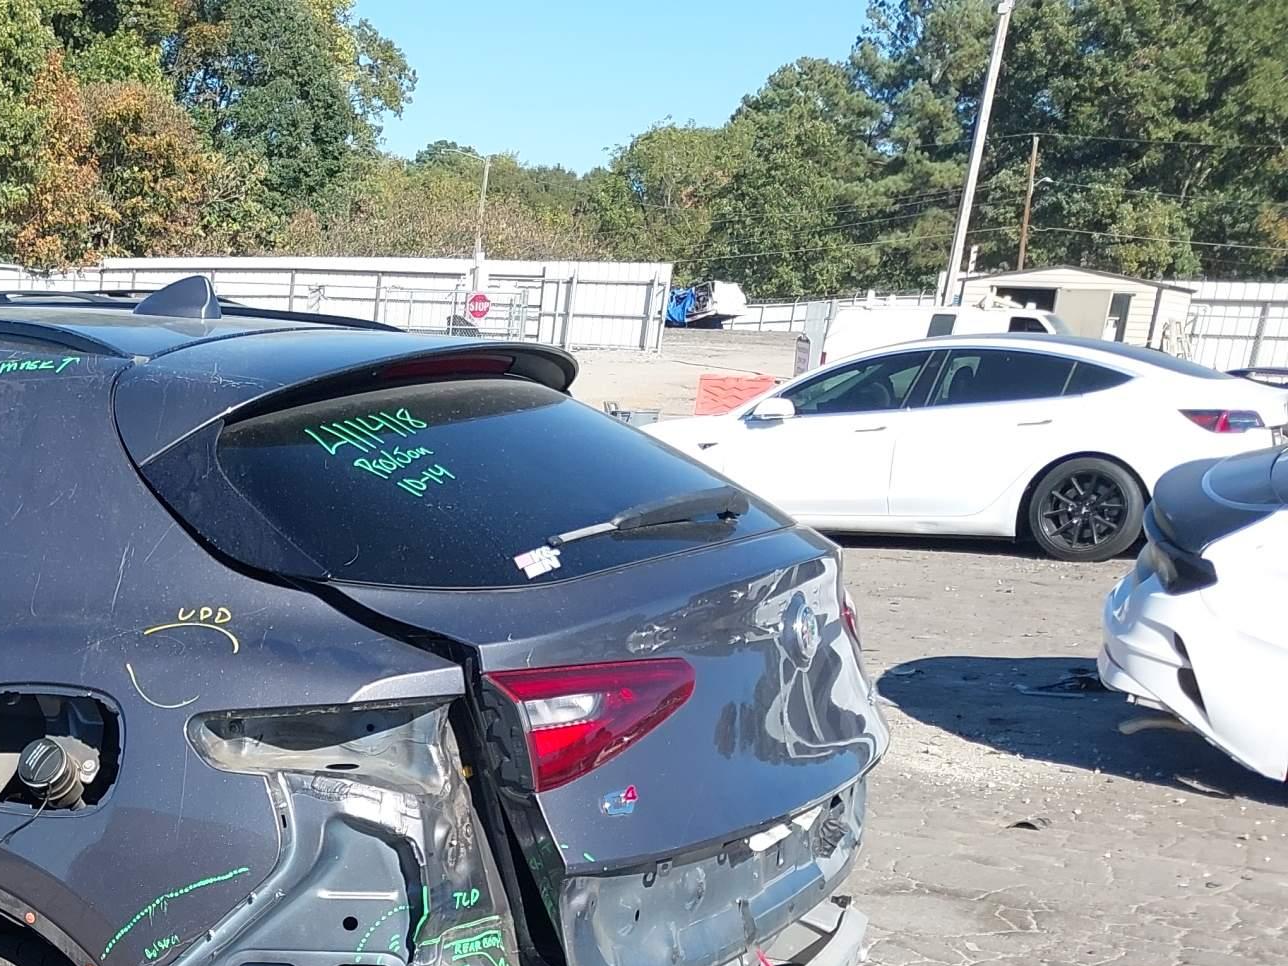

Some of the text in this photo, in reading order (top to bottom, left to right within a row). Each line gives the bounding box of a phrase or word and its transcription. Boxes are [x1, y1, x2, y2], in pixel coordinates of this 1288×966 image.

[469, 301, 490, 312] STOP
[397, 464, 456, 497] 10-14
[178, 606, 232, 624] UPD
[453, 888, 480, 910] TLD
